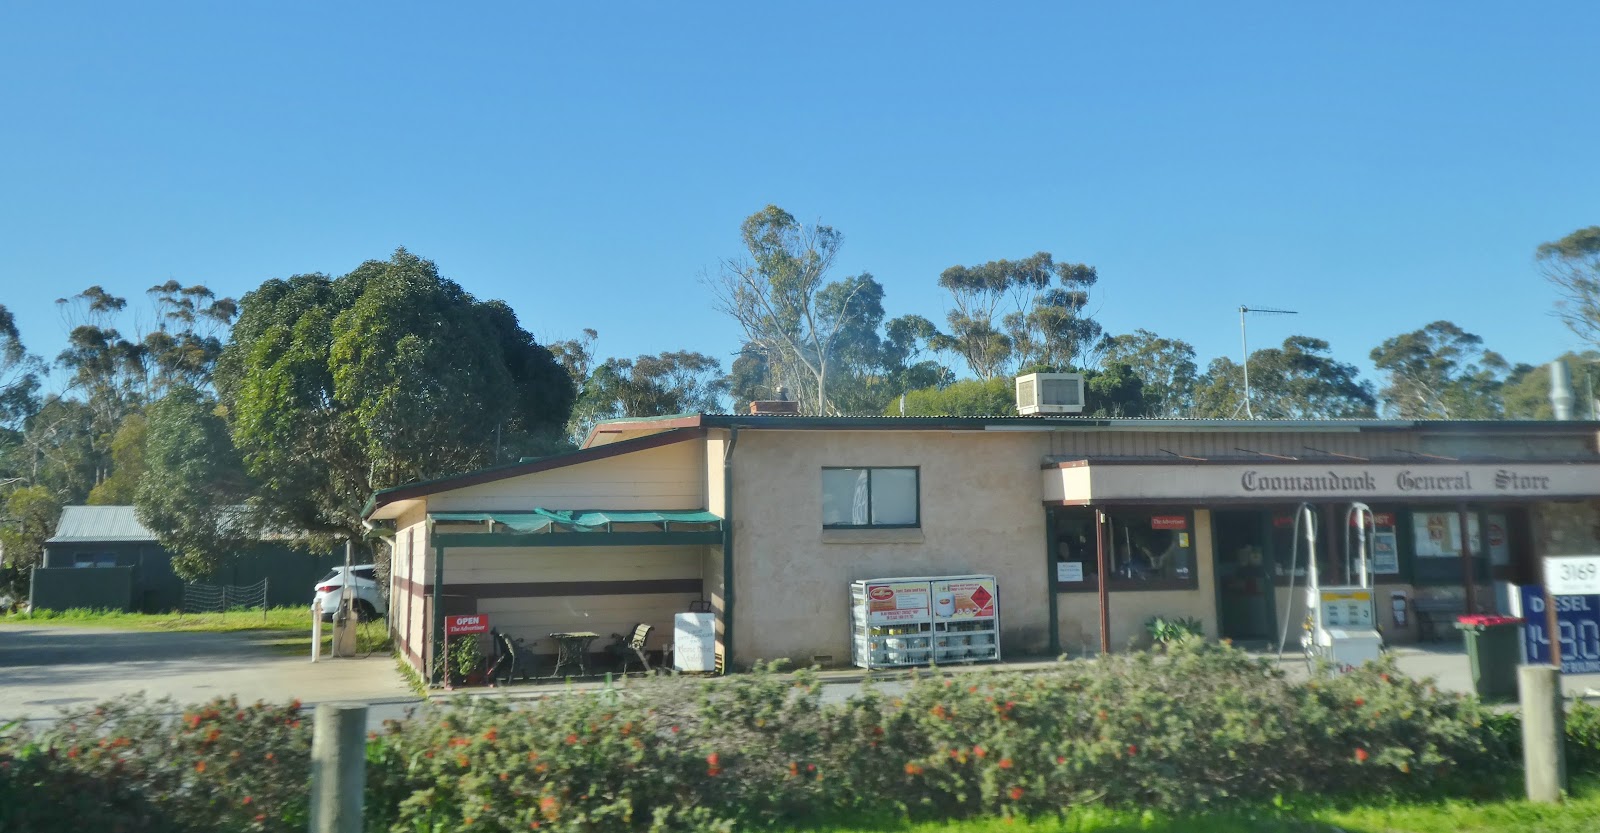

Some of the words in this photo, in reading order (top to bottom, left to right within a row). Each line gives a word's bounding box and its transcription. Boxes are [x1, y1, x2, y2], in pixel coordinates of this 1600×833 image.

[1241, 470, 1376, 492] Coomandook
[1396, 470, 1472, 491] General
[1494, 469, 1550, 491] Store
[1560, 563, 1597, 581] 3169
[1529, 595, 1591, 613] DESEL
[456, 617, 479, 625] OPEN
